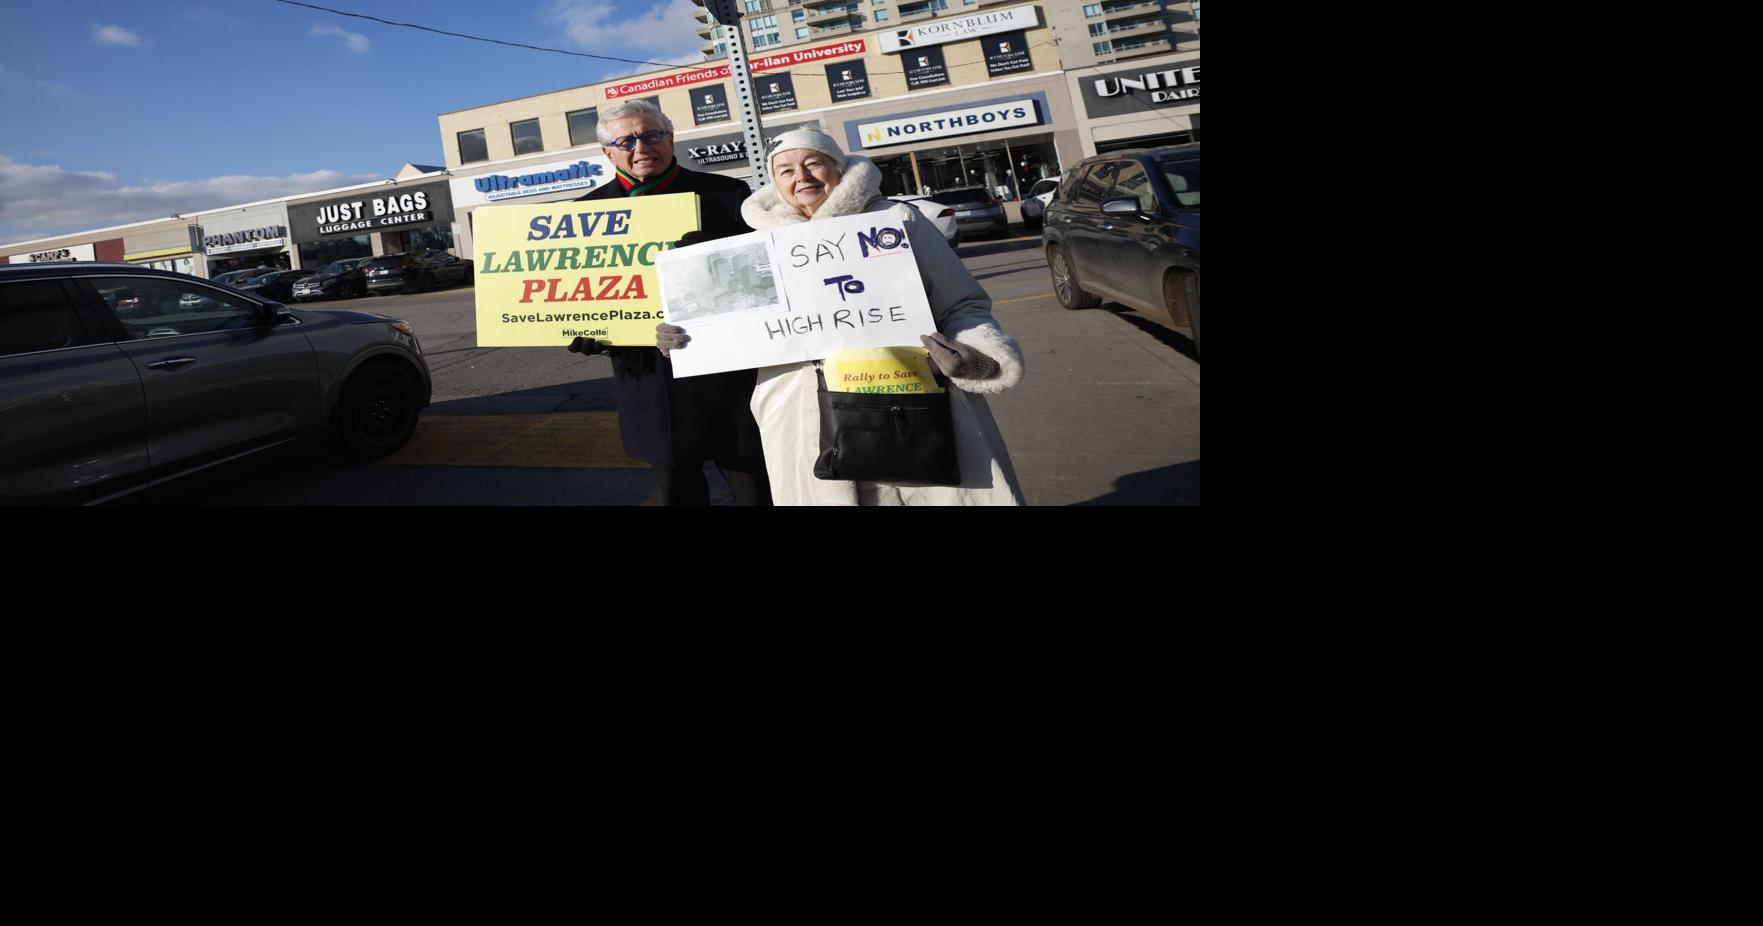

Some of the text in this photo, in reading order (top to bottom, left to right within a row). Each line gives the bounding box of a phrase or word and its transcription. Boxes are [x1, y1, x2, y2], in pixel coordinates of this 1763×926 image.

[918, 11, 1013, 36] KORNBLUM
[955, 27, 977, 37] LAW
[620, 77, 674, 95] Canadian
[675, 68, 719, 85] Friends
[749, 56, 791, 70] ar-Ilan
[797, 42, 862, 62] University
[1151, 87, 1200, 103] DAIR
[887, 107, 1026, 137] NORTHBOYS
[688, 140, 741, 159] X-RAY
[697, 153, 738, 164] ULTRASOUND
[474, 160, 603, 193] Ultramatic
[488, 191, 521, 200] ADJUSTABLE
[551, 180, 589, 191] MATTRESSES
[317, 191, 427, 225] JUST BAGS
[202, 225, 279, 248] PHANTOM
[320, 212, 425, 234] LUGGAGE CENTER
[527, 209, 632, 242] SAVE
[480, 240, 677, 274] LAWRENC
[790, 232, 847, 268] SAY
[857, 227, 910, 258] NO!
[519, 274, 648, 304] PLAZA
[764, 305, 907, 340] HIGH RISE
[844, 370, 920, 383] Rally to Save
